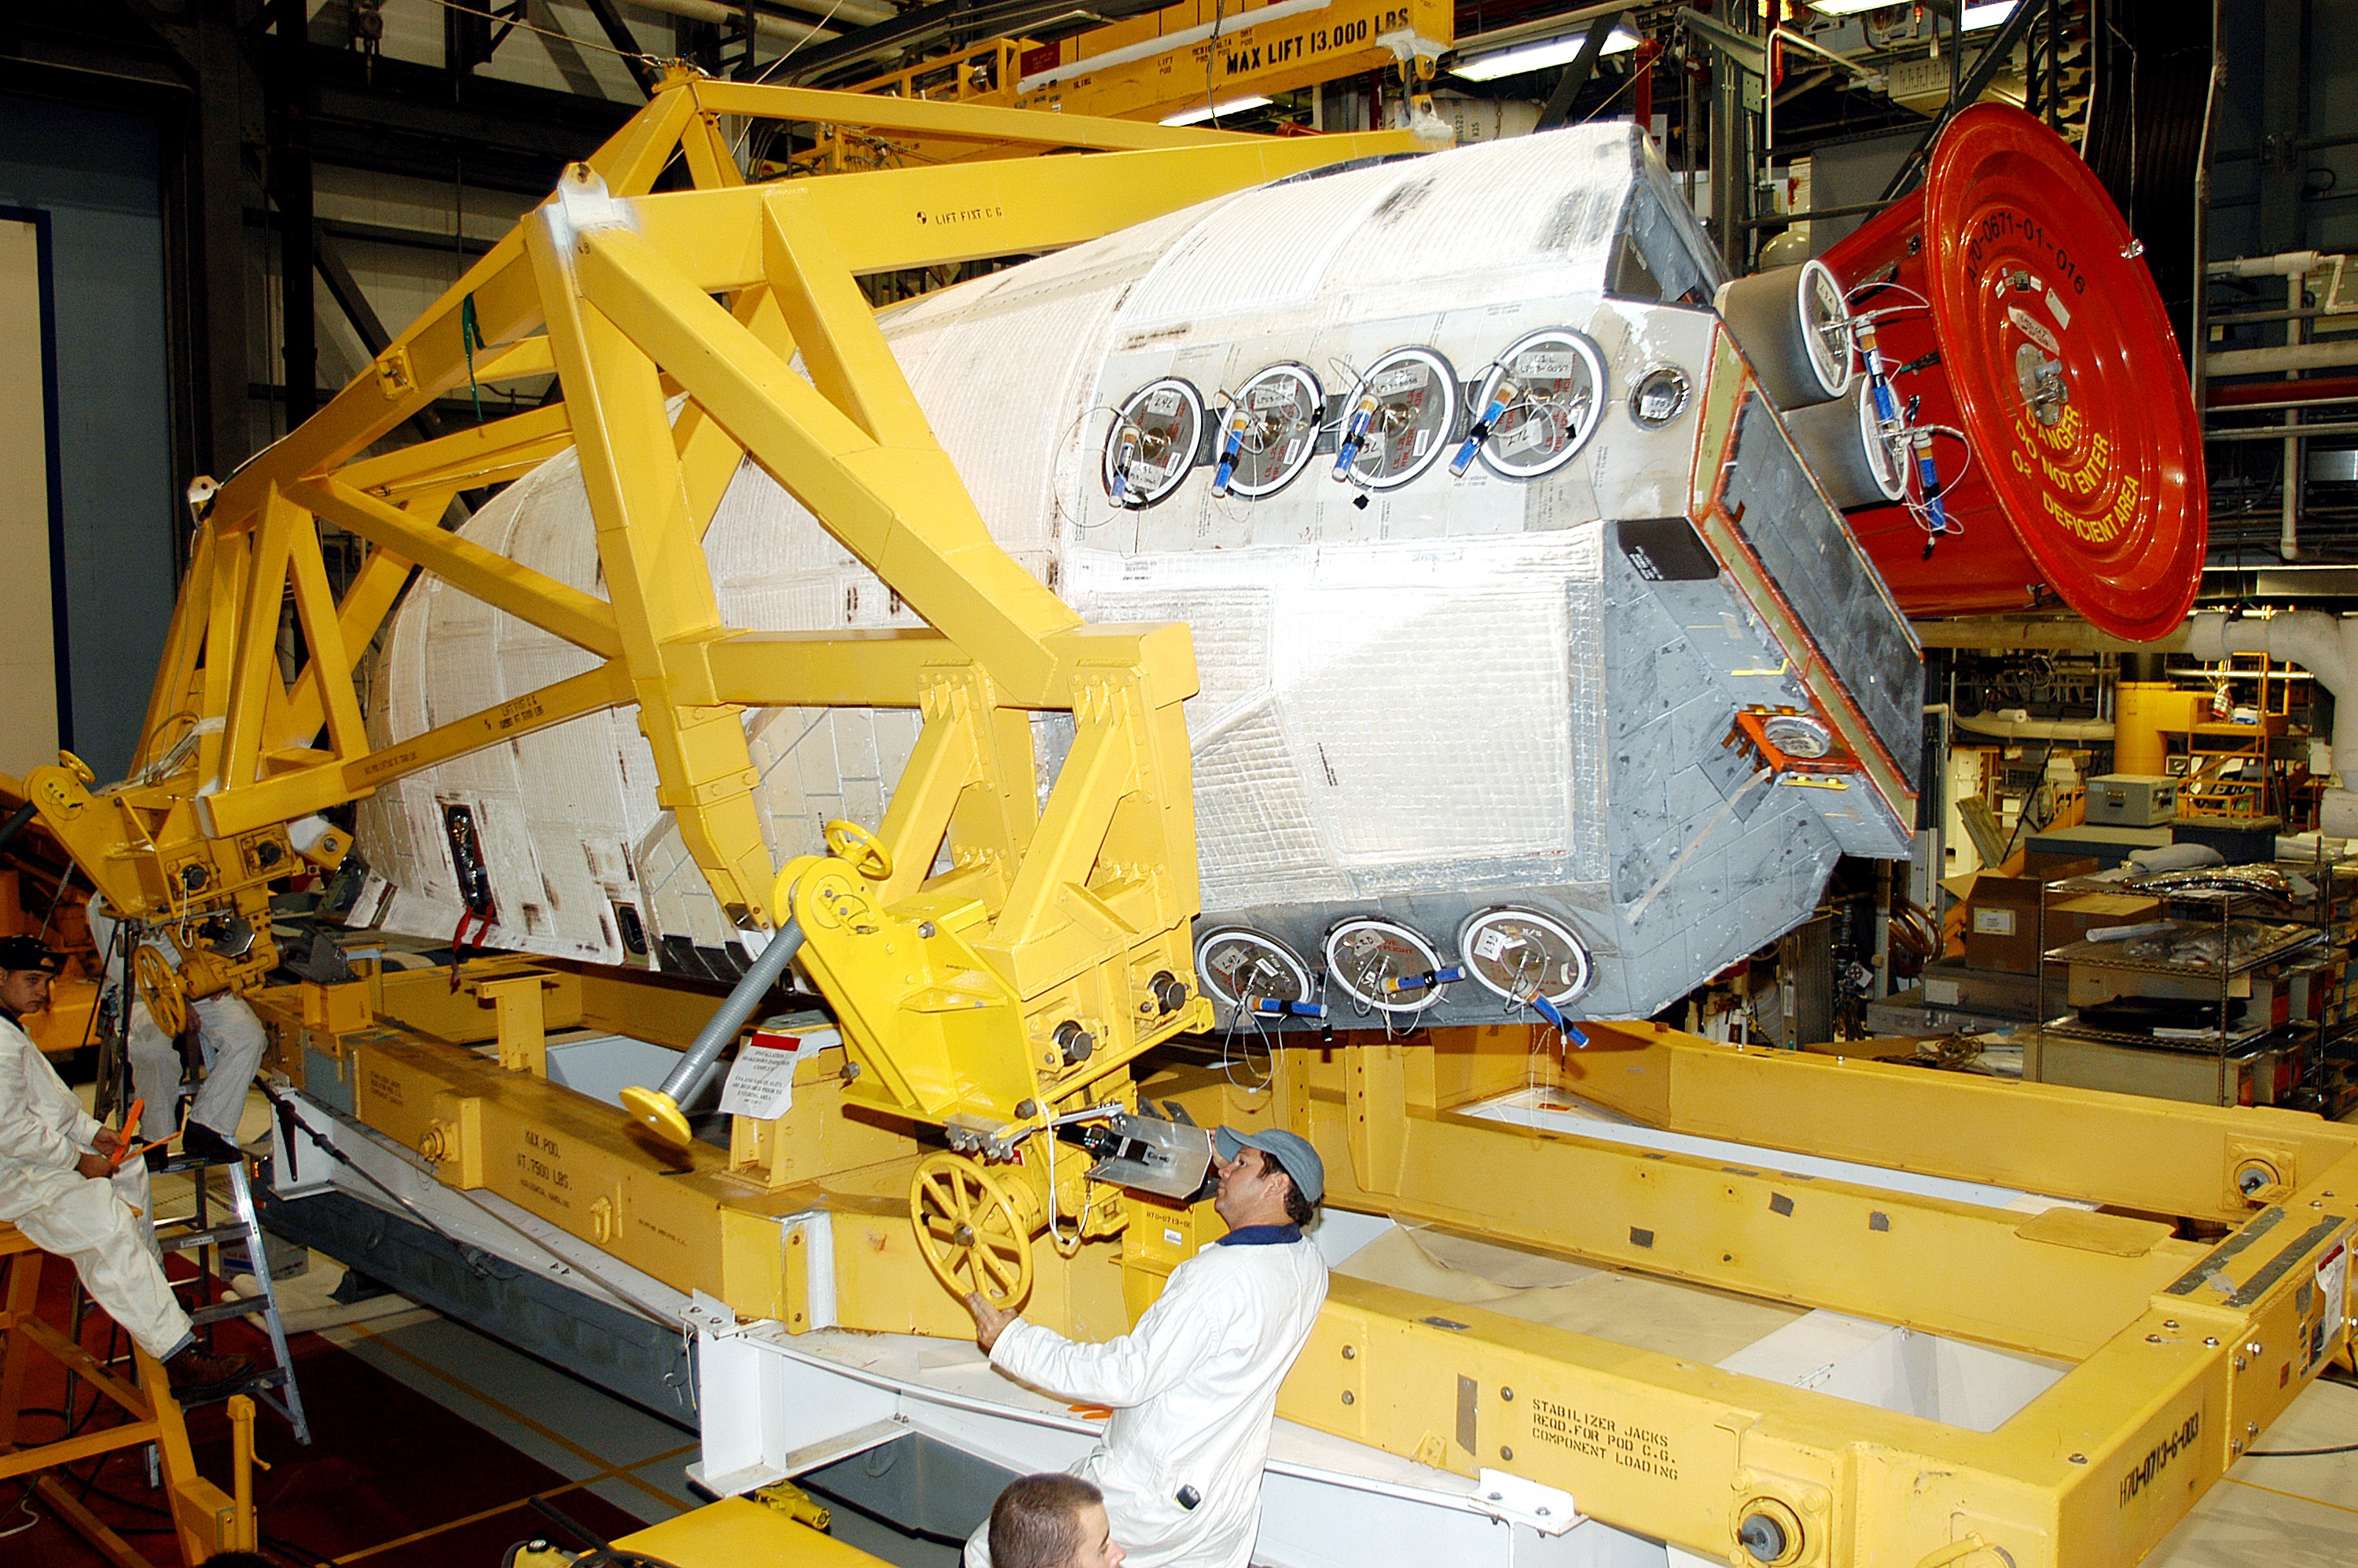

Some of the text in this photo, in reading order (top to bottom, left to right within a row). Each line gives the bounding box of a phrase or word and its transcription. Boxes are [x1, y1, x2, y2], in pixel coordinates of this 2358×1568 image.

[1157, 57, 1173, 67] LIFT
[1226, 8, 1409, 75] MAX LIFT 13,000 LBS
[935, 212, 956, 225] LIFT
[960, 209, 981, 222] FIXT
[2026, 405, 2079, 450] DANGER
[2015, 419, 2109, 494] DO NOT ENTER
[2042, 490, 2119, 543] DEFICIENT
[2114, 475, 2139, 528] AREA
[1383, 946, 1414, 954] FLIGHT
[1532, 1397, 1669, 1447] STABILIZER JACKS
[1607, 1434, 1633, 1451] POD
[1532, 1427, 1678, 1481] COMPONENT LOADING
